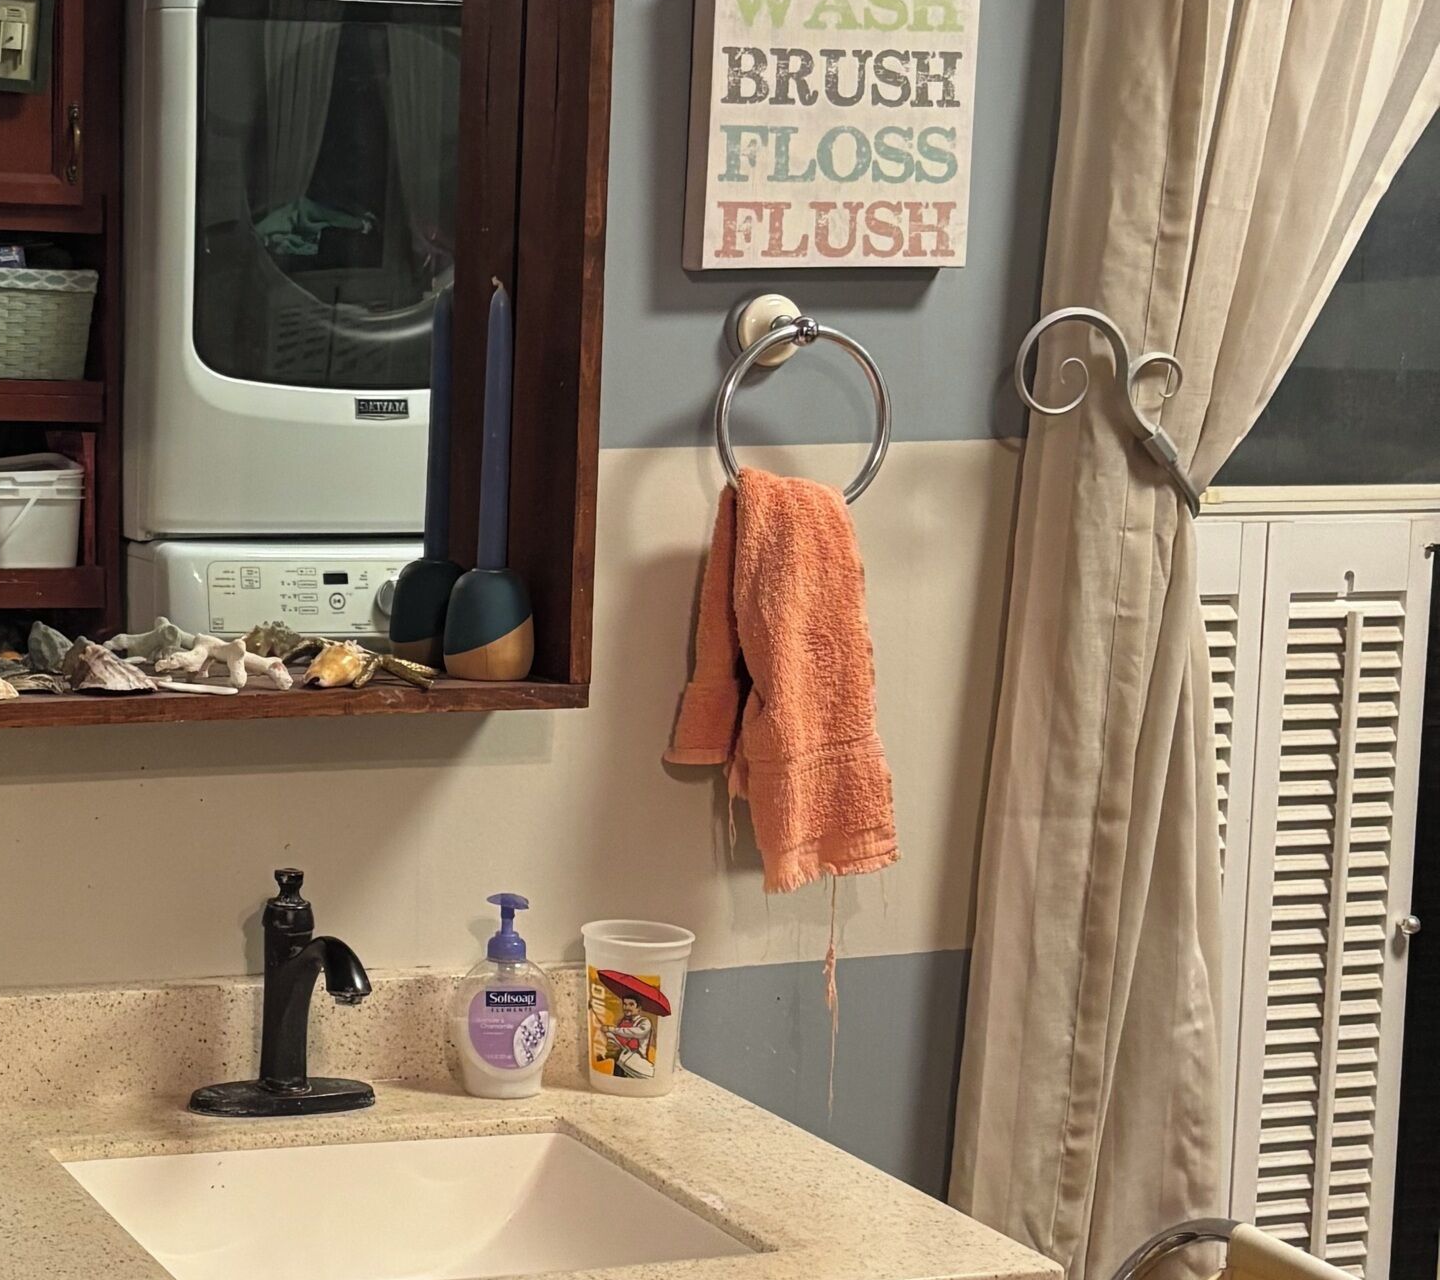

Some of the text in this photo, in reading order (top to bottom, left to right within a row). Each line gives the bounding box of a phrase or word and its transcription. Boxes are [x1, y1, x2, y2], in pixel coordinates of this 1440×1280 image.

[720, 46, 963, 108] BRUSH
[717, 124, 959, 184] FLOSS
[714, 200, 957, 258] FLUSH
[489, 992, 535, 1006] Softsoap
